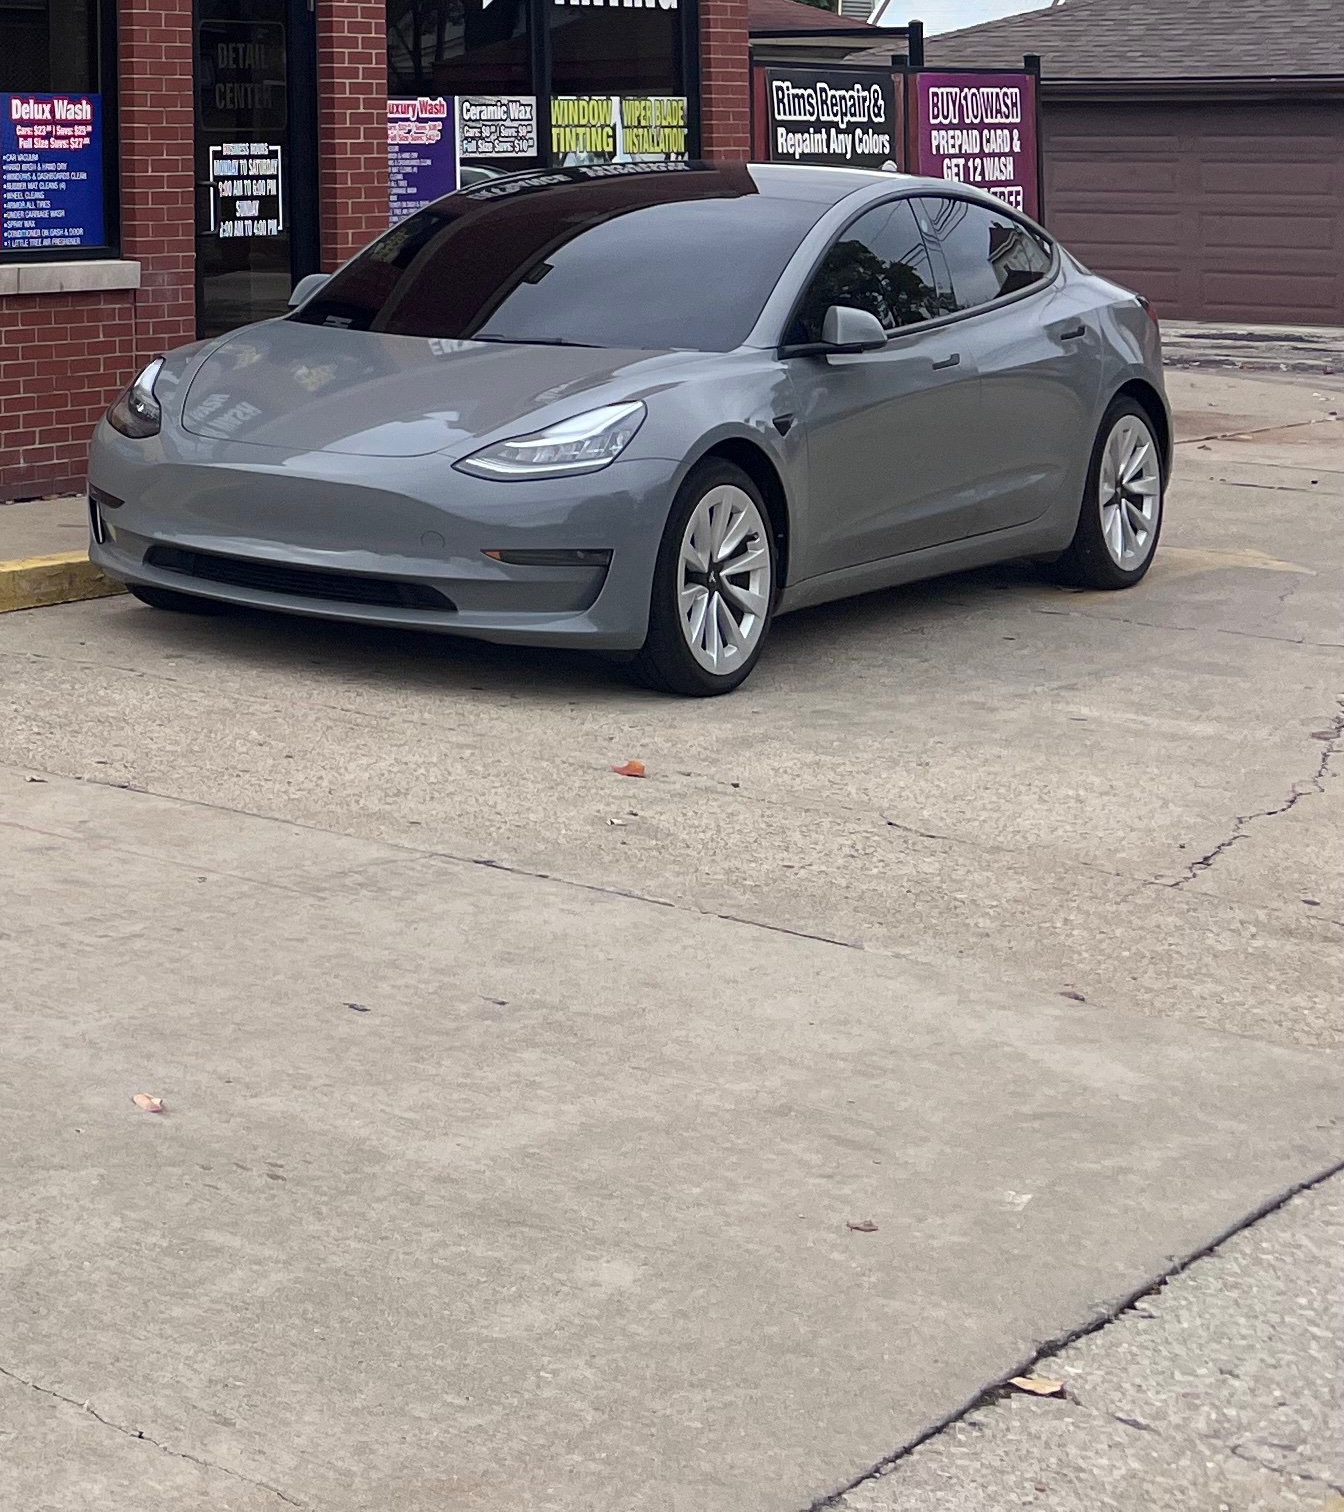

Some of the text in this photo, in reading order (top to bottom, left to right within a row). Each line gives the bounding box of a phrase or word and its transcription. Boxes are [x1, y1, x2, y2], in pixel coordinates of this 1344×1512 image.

[11, 99, 91, 119] Delux Wash
[389, 99, 445, 118] uxury Wash
[463, 101, 532, 120] Ceramic Wax
[552, 99, 612, 126] WINDOW
[623, 99, 684, 126] WIPER BLADE
[774, 83, 884, 127] Rims Repair &
[930, 89, 1020, 122] BUY 10 WASH
[552, 127, 613, 152] TINTING
[623, 128, 686, 153] INSTALLATION
[777, 127, 890, 159] Repaint Any Colors
[931, 129, 1021, 155] PREPAID CARD &
[943, 156, 1013, 182] GET 12 WASH
